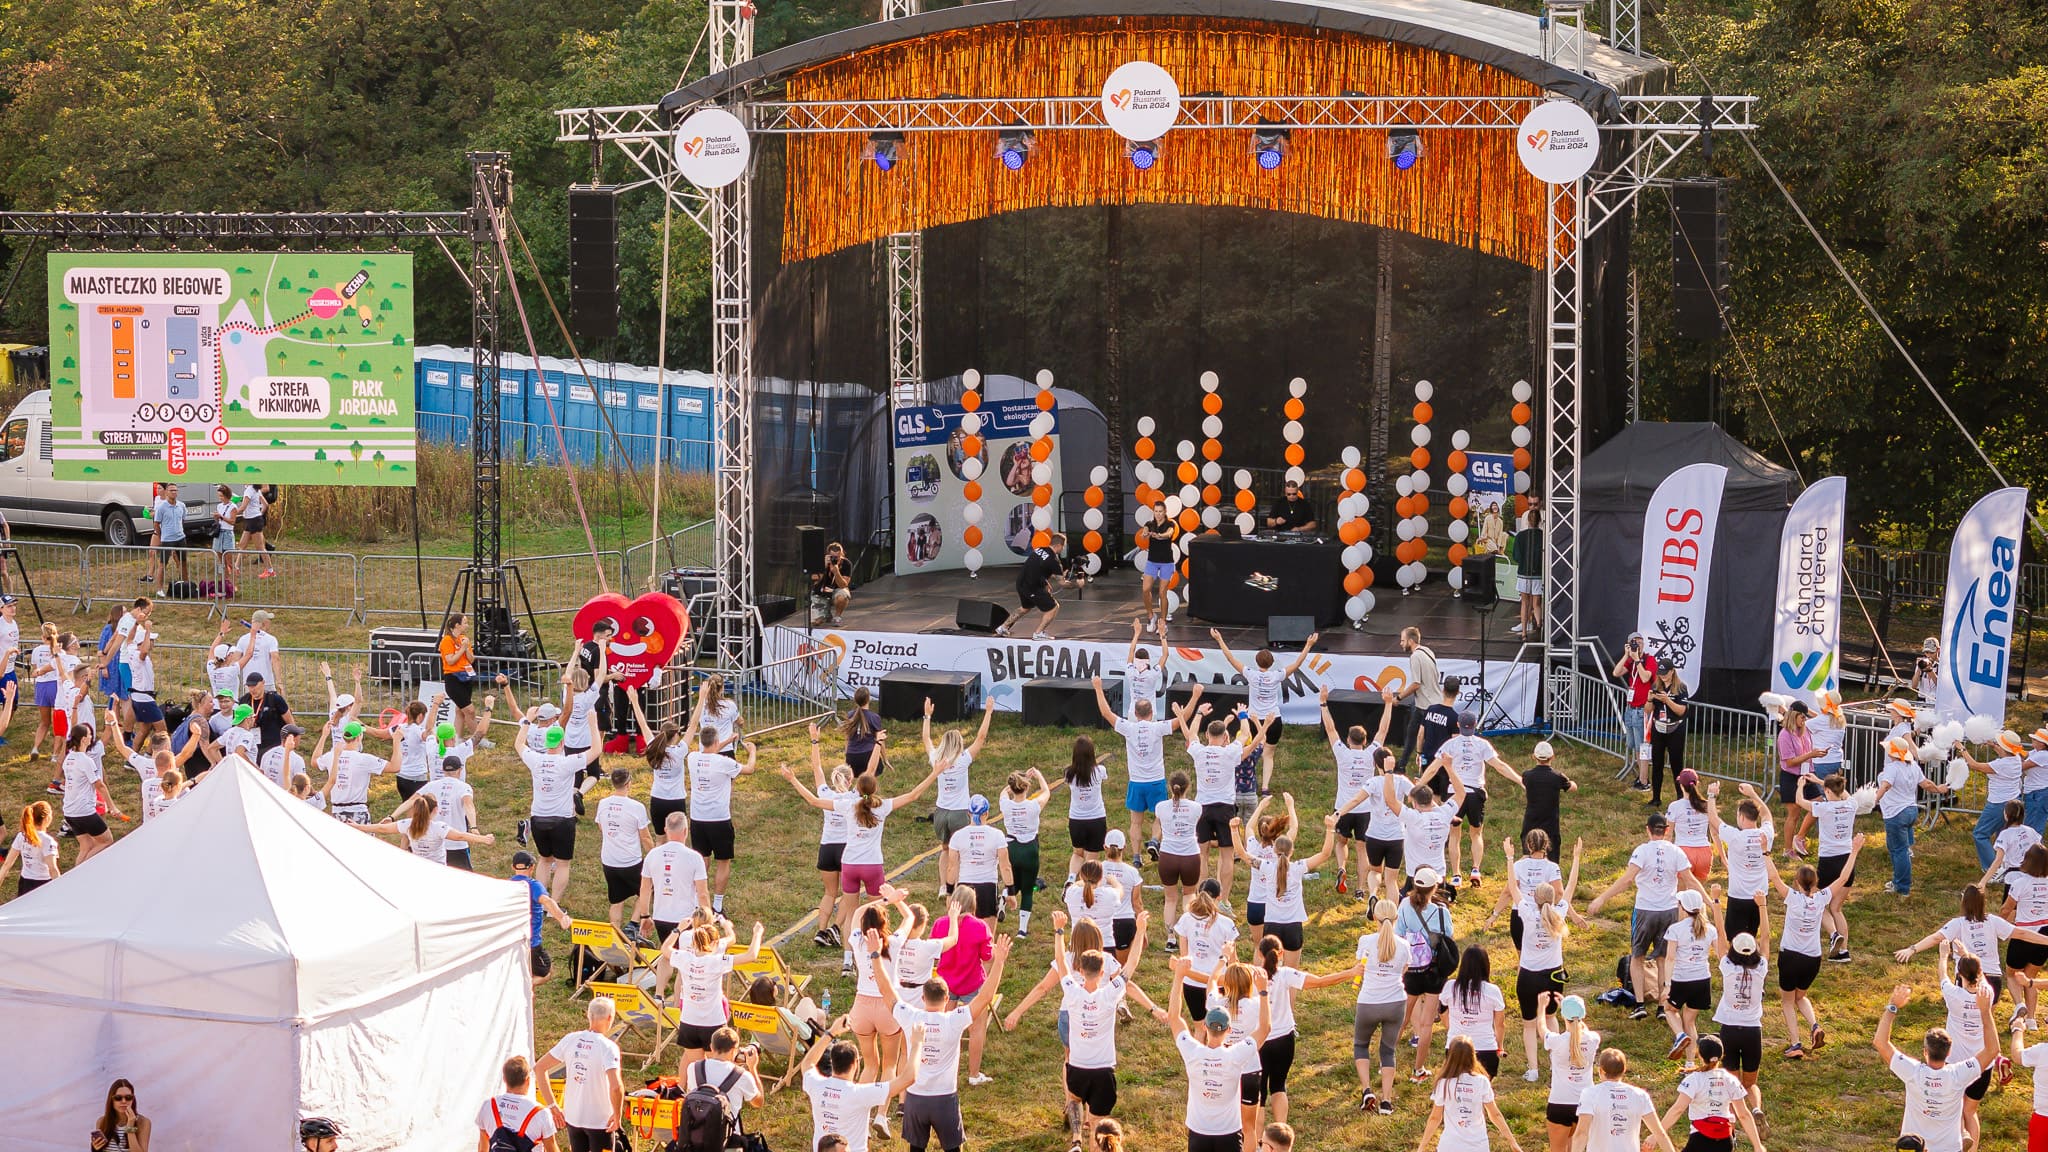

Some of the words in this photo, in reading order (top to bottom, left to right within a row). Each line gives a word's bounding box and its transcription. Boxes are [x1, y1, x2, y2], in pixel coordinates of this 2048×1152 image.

[1550, 136, 1585, 144] Business
[1551, 129, 1580, 137] Poland
[720, 147, 740, 155] 2024
[1567, 142, 1588, 150] 2024
[70, 275, 157, 296] MIASTECZKO
[163, 275, 223, 296] BIEGOWE
[345, 273, 367, 296] SCENA
[269, 382, 310, 397] STREFA
[352, 379, 384, 398] PARK
[144, 407, 150, 417] 2
[164, 407, 169, 417] 3
[184, 408, 190, 417] 4
[203, 408, 208, 418] 5
[258, 398, 321, 414] PIKNIKOWA
[338, 398, 398, 417] JORDANA
[103, 431, 134, 444] STREFA
[136, 432, 165, 444] ZMIAN
[171, 431, 185, 470] START
[1657, 508, 1703, 605] UBS
[1797, 532, 1815, 636] standard
[1811, 526, 1828, 636] chartered
[1969, 535, 2016, 689] Enea
[852, 639, 918, 657] Poland
[987, 645, 1101, 682] BIEGAM
[846, 671, 881, 687] Run
[1424, 711, 1448, 727] MEDIA
[573, 927, 593, 937] RMF
[733, 1010, 755, 1020] RMF
[632, 1106, 654, 1116] RM
